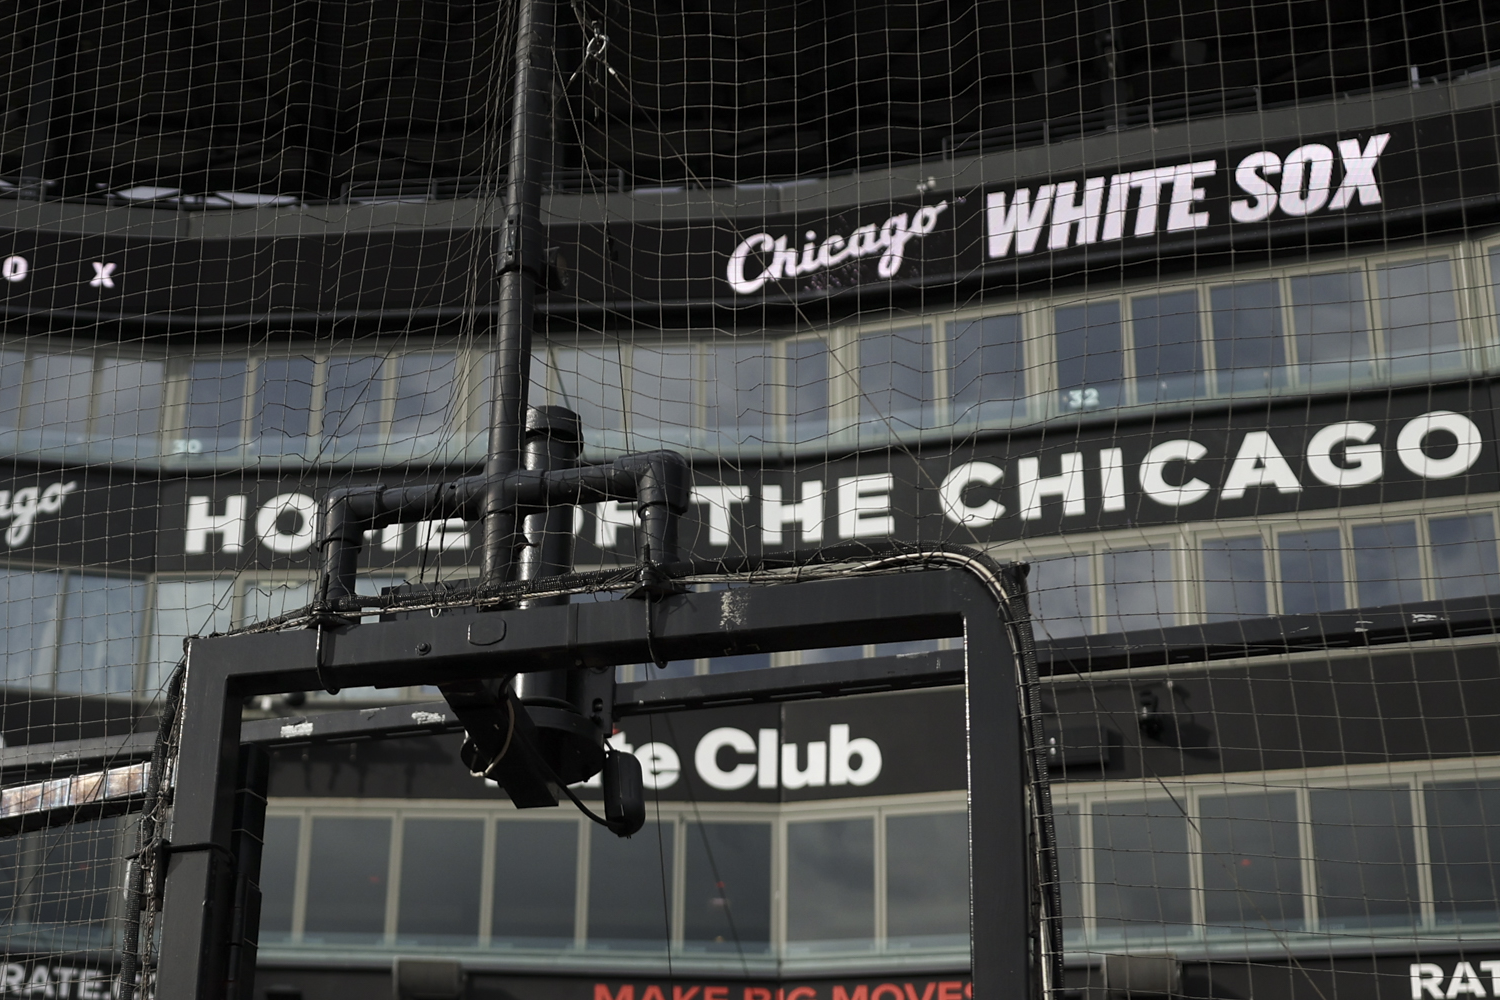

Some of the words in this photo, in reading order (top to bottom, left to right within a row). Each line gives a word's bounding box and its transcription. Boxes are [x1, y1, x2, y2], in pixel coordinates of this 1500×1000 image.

[726, 201, 948, 294] Chicago
[986, 160, 1218, 259] WHITE
[1230, 133, 1391, 223] SOX
[184, 492, 472, 555] HOE
[689, 472, 895, 546] THE
[939, 409, 1484, 530] CHICAGO
[695, 723, 883, 790] Club
